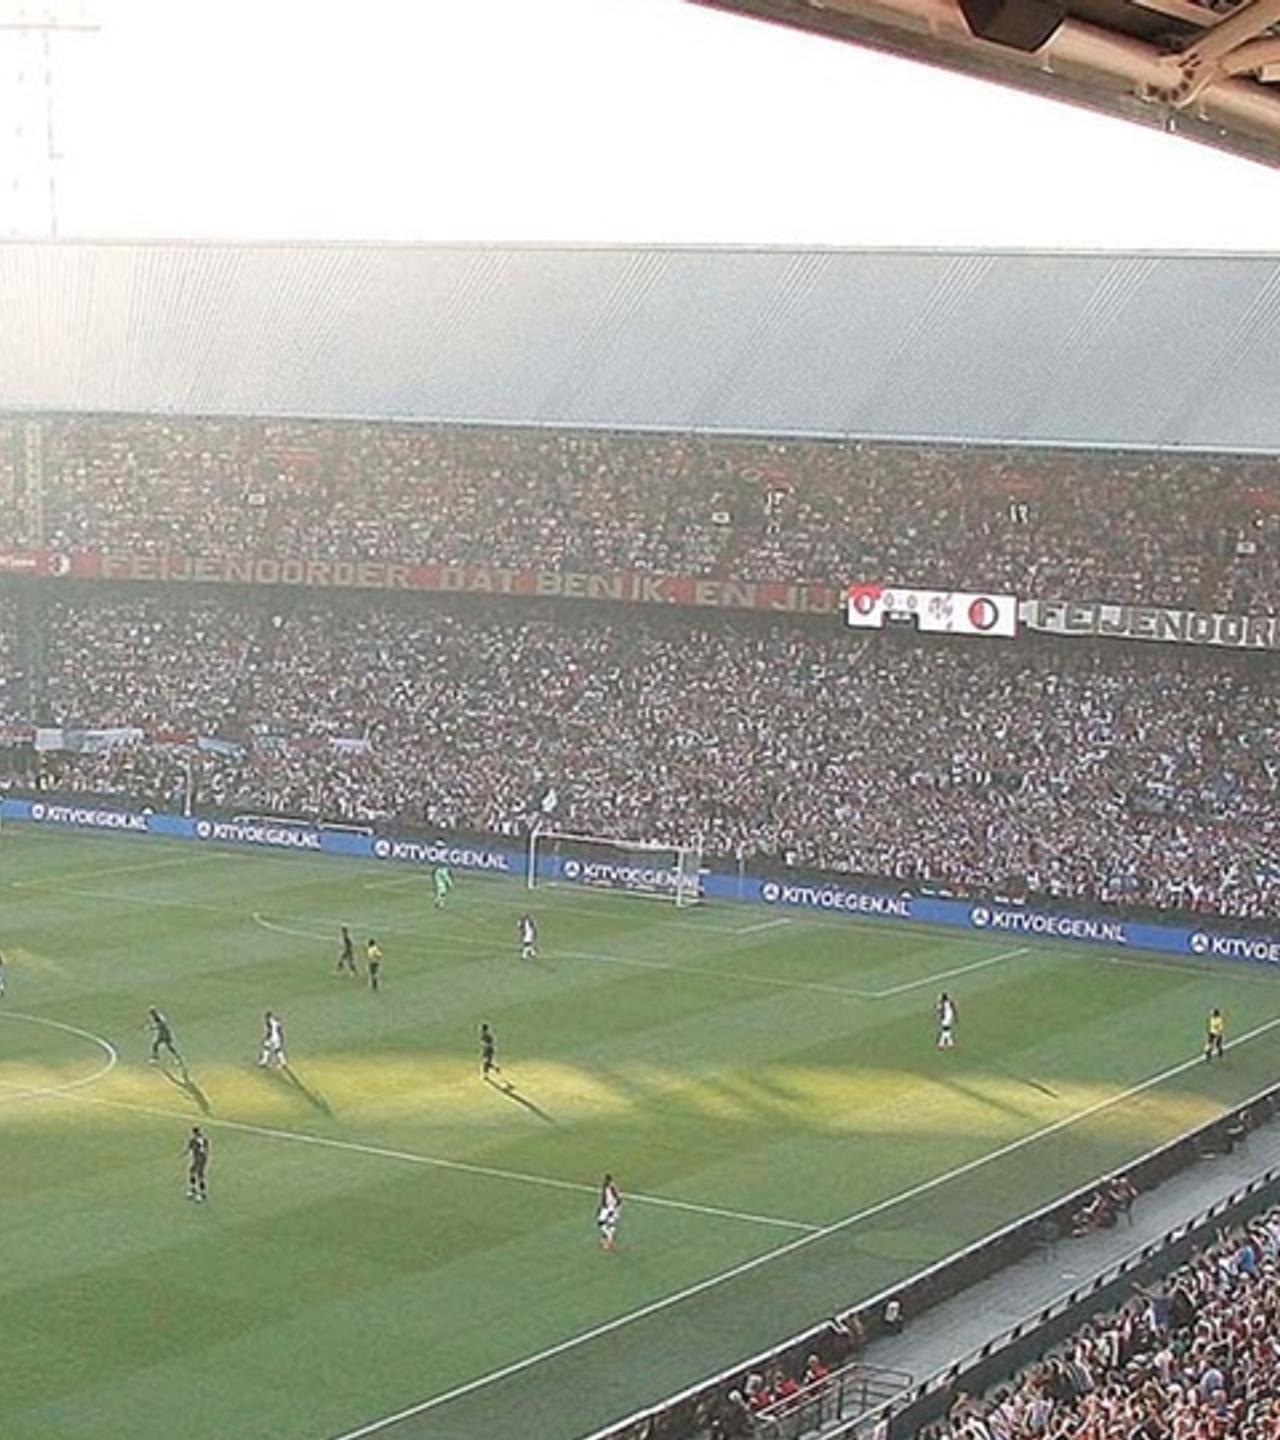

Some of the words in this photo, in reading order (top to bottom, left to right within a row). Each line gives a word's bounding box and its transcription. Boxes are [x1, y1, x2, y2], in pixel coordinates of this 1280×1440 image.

[536, 571, 622, 599] BEN
[696, 580, 757, 607] EN
[1039, 601, 1280, 646] FEIJENOOR
[782, 885, 911, 916] KITVOEGEN.NL
[992, 911, 1127, 942] KITVOEGEN.NL
